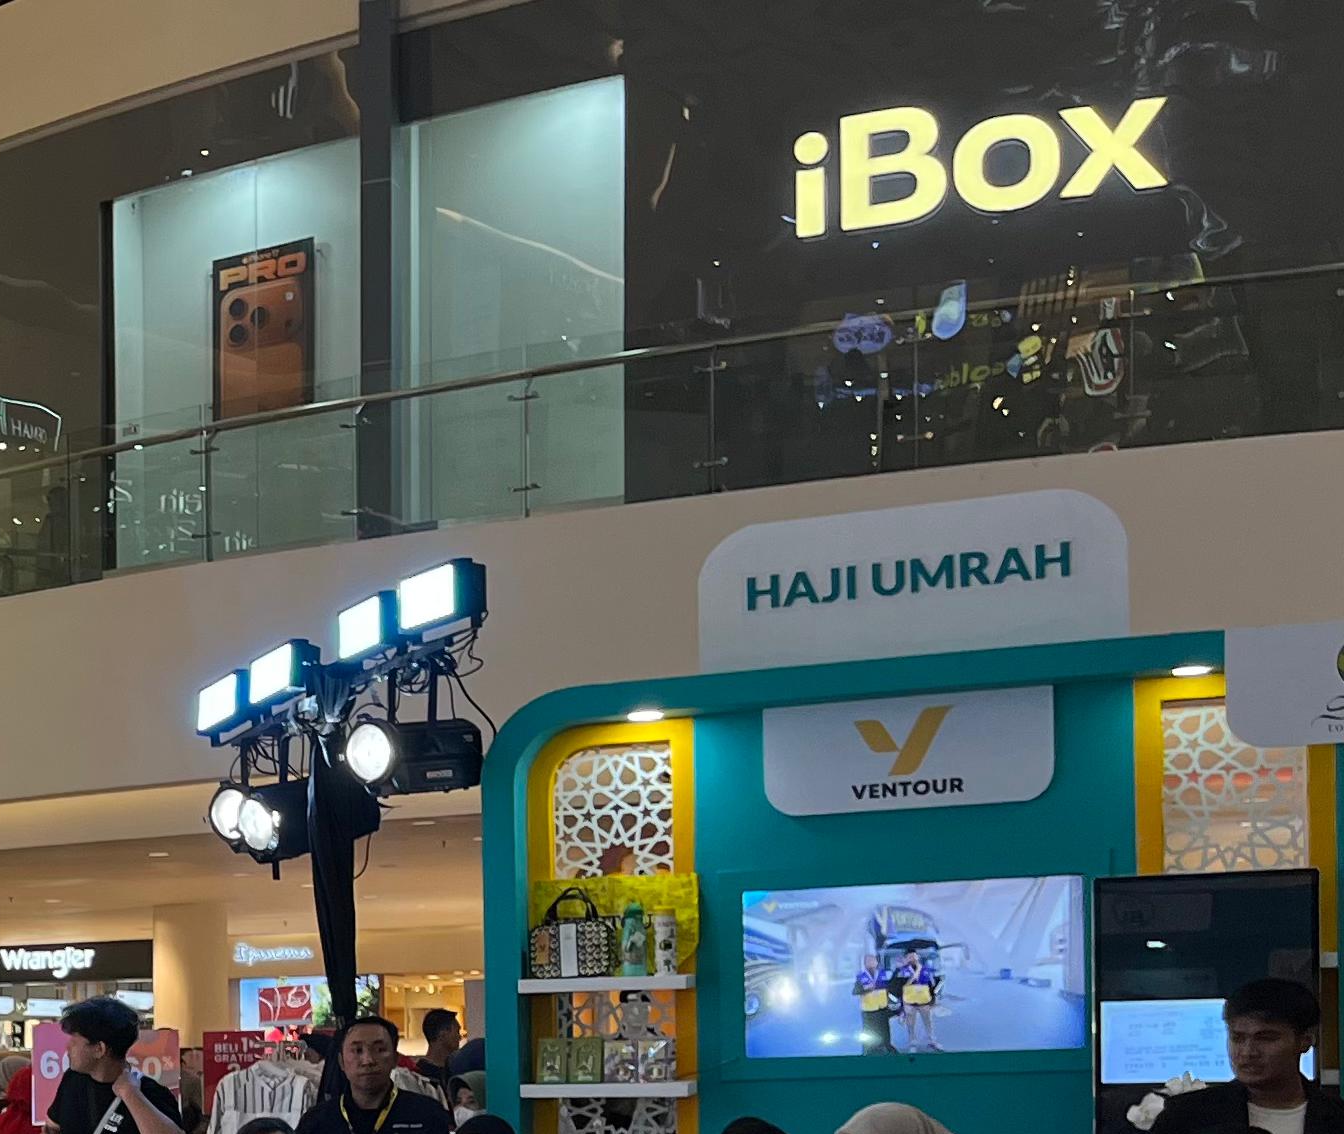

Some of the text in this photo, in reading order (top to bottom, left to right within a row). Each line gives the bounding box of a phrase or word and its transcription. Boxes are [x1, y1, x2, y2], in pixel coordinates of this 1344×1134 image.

[793, 97, 1169, 239] iBox
[219, 251, 307, 291] PRO
[745, 541, 1073, 612] HAJI UMRAH
[852, 776, 965, 801] VENTOUR
[0, 946, 96, 979] Wrangler
[214, 1043, 239, 1053] BELI
[214, 1054, 255, 1063] GRATIS
